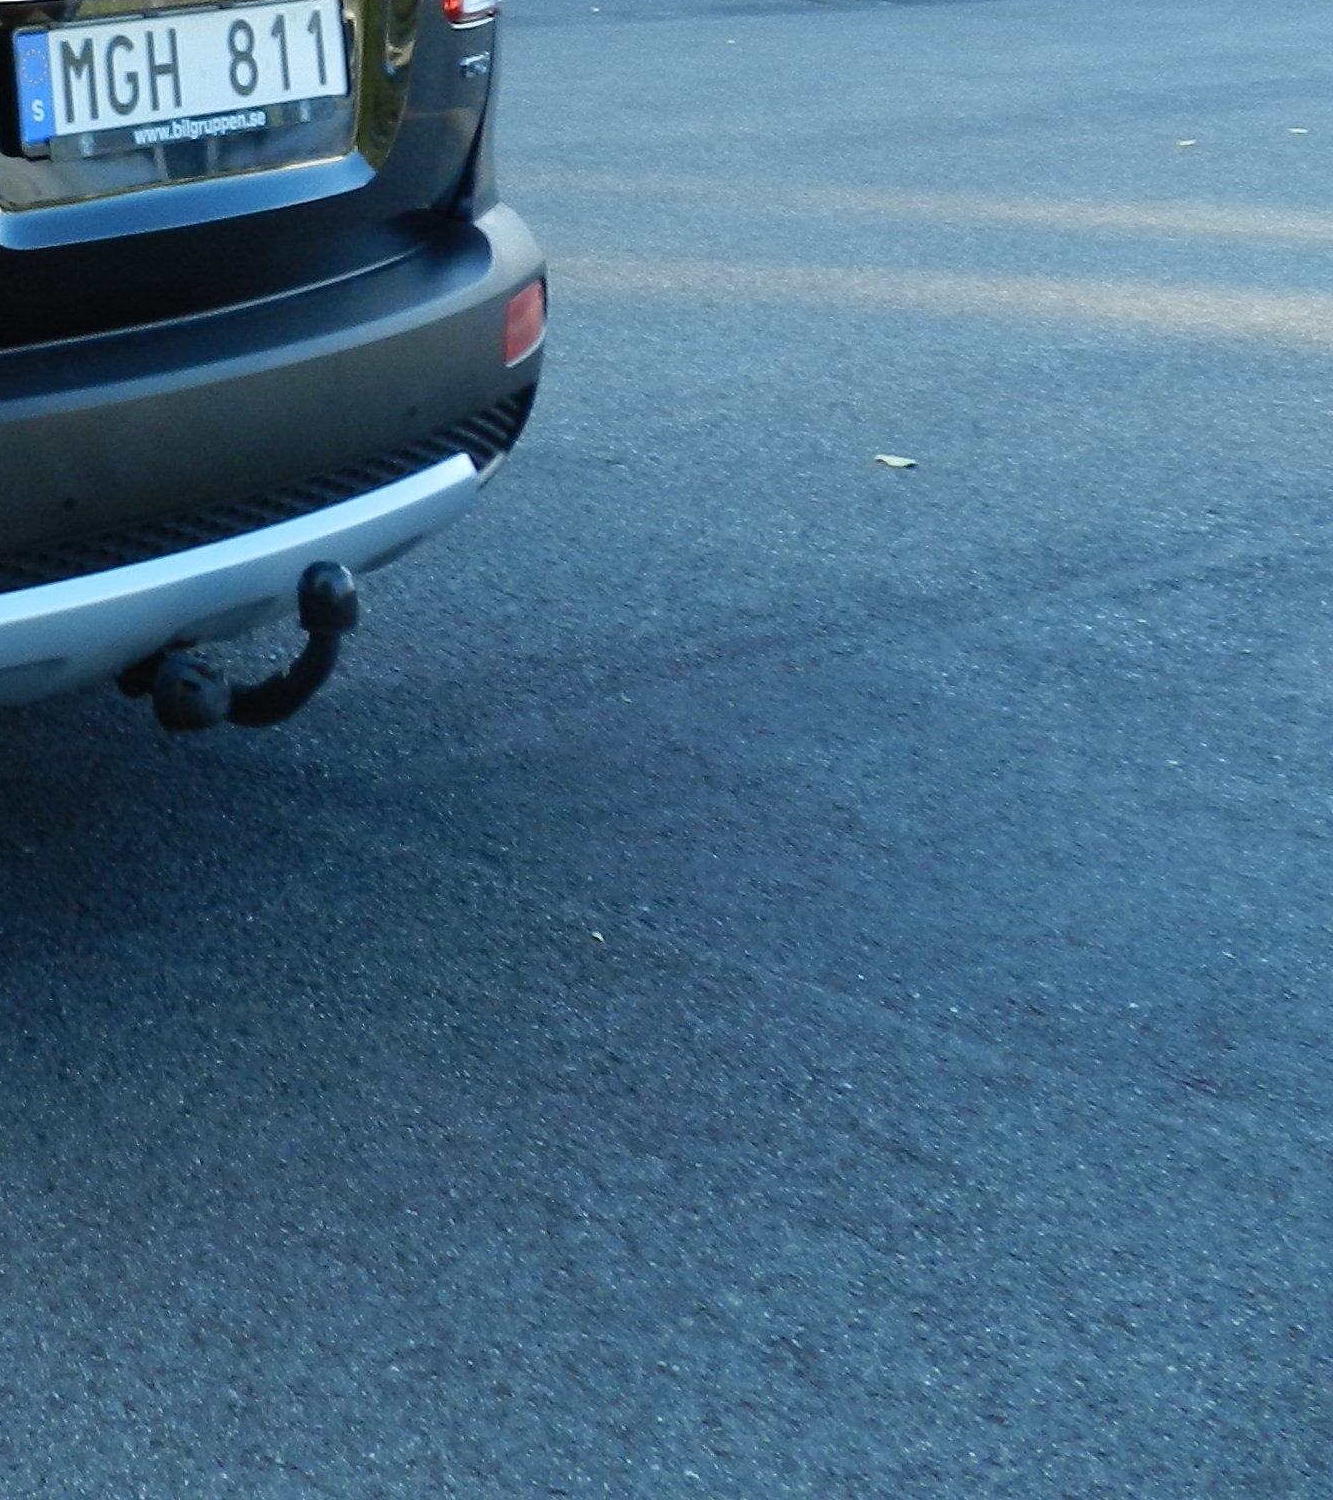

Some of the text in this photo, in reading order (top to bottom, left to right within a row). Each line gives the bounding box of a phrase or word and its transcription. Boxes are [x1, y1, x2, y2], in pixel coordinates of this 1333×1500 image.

[59, 9, 327, 123] MGH 811
[31, 100, 46, 122] S
[133, 110, 267, 145] www.bilgruppen.se
